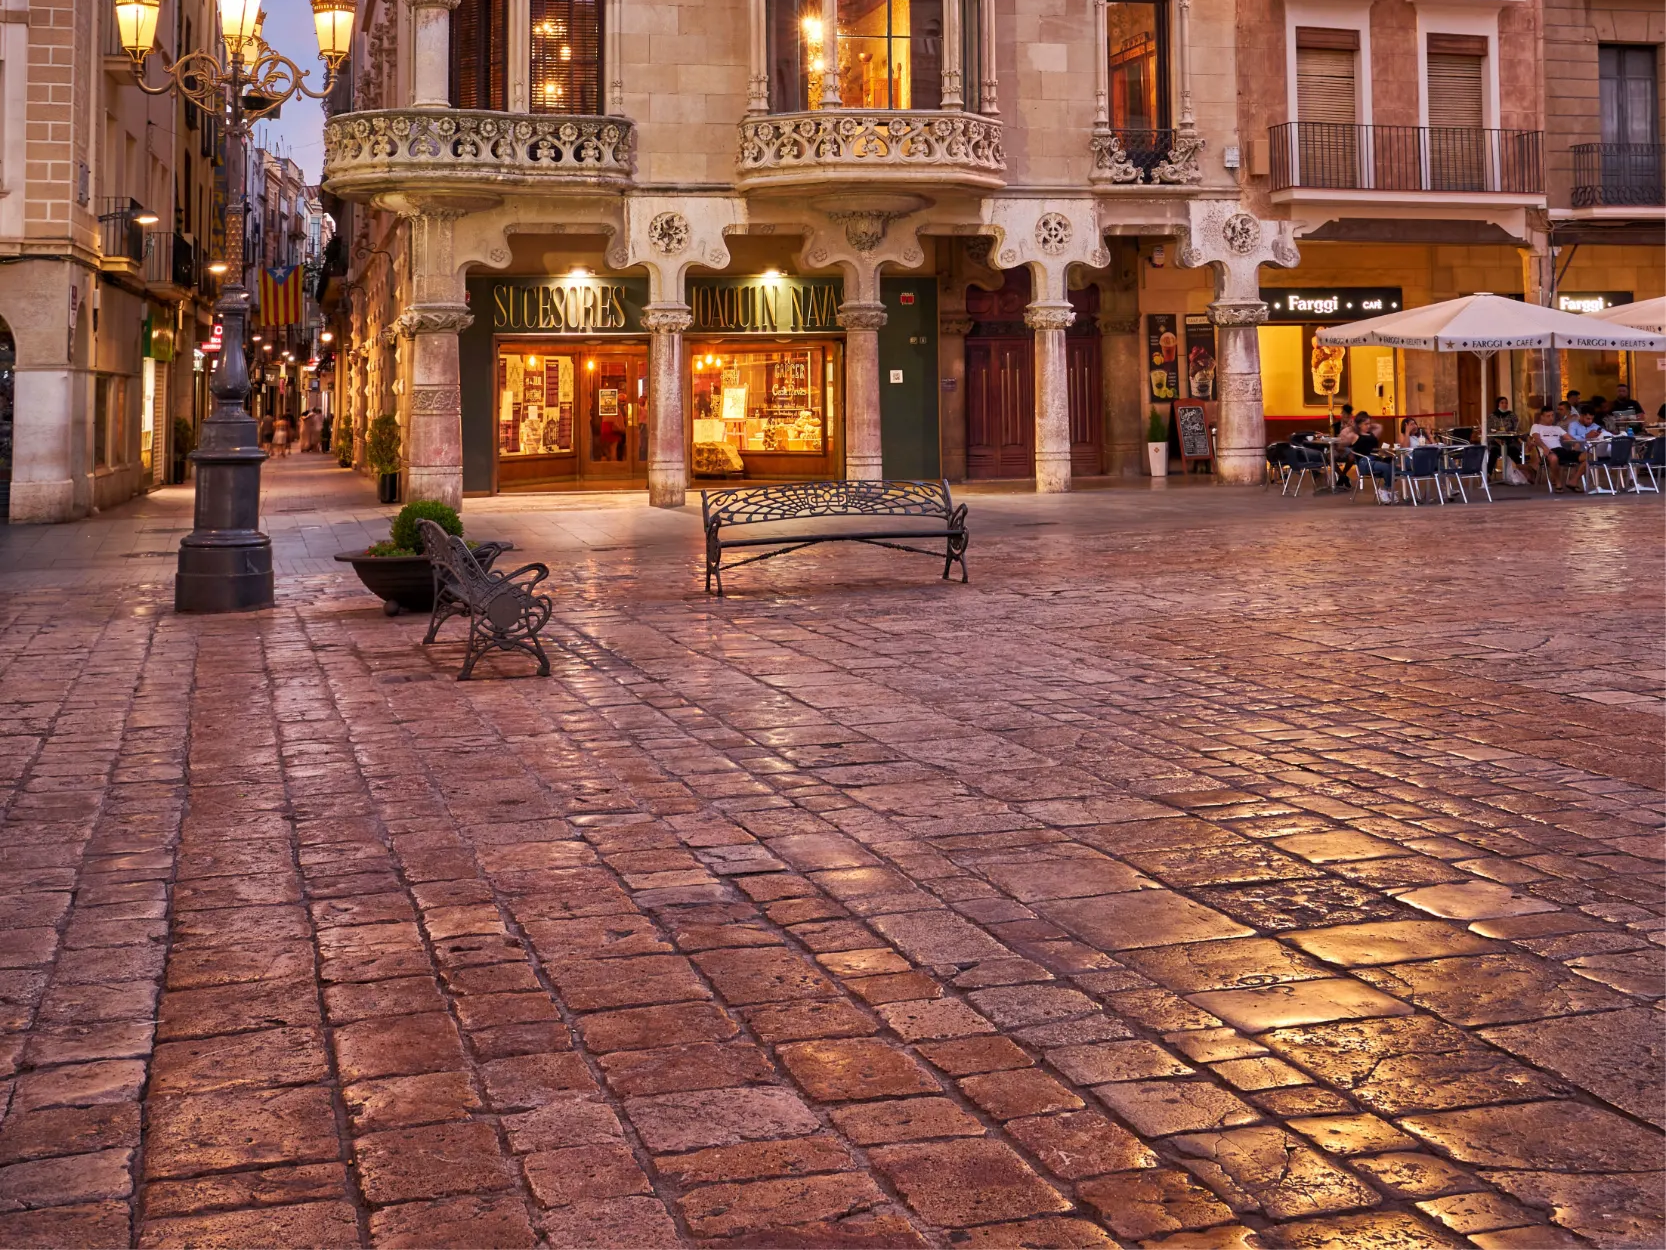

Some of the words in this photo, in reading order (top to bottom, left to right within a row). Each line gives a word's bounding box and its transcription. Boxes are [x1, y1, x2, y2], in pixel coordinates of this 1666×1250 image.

[493, 284, 626, 329] SUCESORES
[690, 284, 778, 329] JOAQUIN
[789, 284, 844, 328] NAVA
[1288, 295, 1339, 313] Farggi
[1559, 297, 1603, 312] Farggi
[1472, 339, 1503, 348] FARGGI
[1577, 338, 1607, 347] FARGGI
[1620, 339, 1646, 348] GELATS
